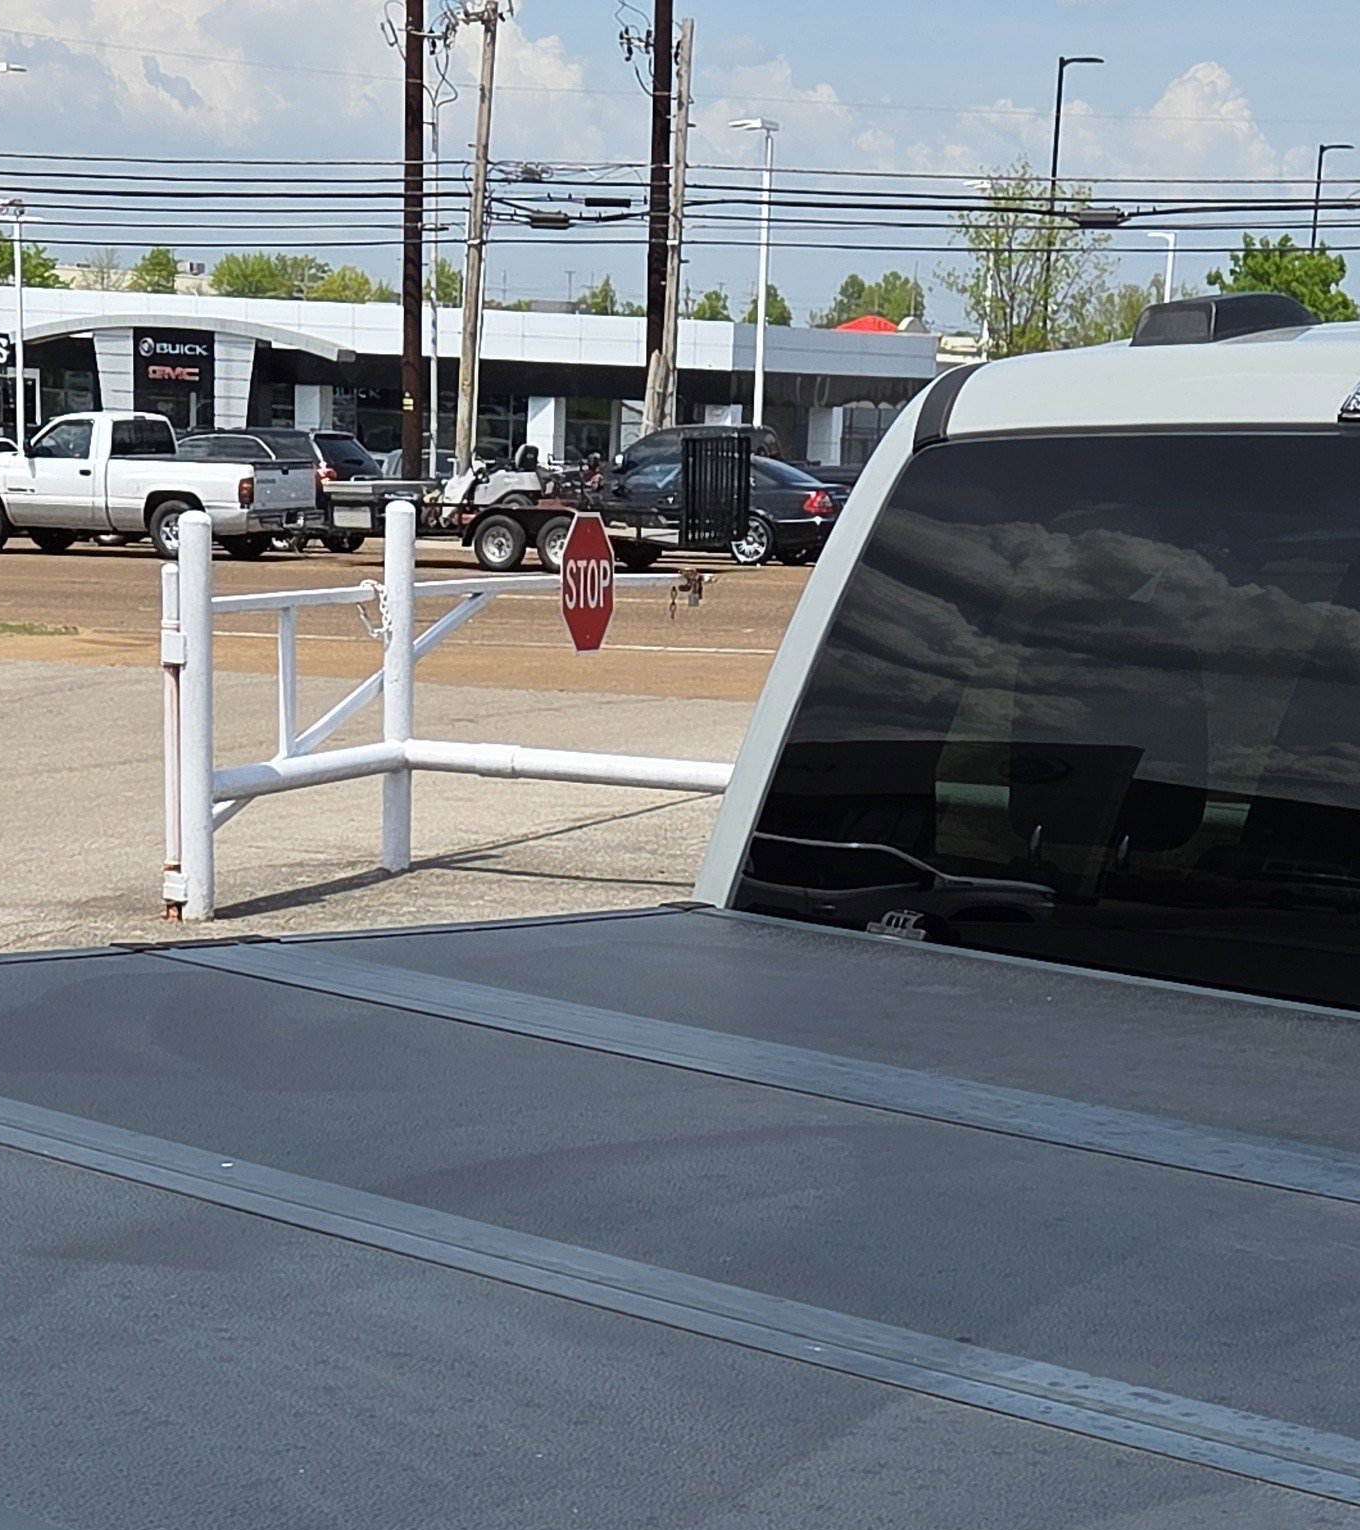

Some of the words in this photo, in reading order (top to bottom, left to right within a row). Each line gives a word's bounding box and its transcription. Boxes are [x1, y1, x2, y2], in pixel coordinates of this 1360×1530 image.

[156, 342, 209, 356] BUICK
[148, 365, 199, 381] GMC
[565, 559, 611, 609] STOP
